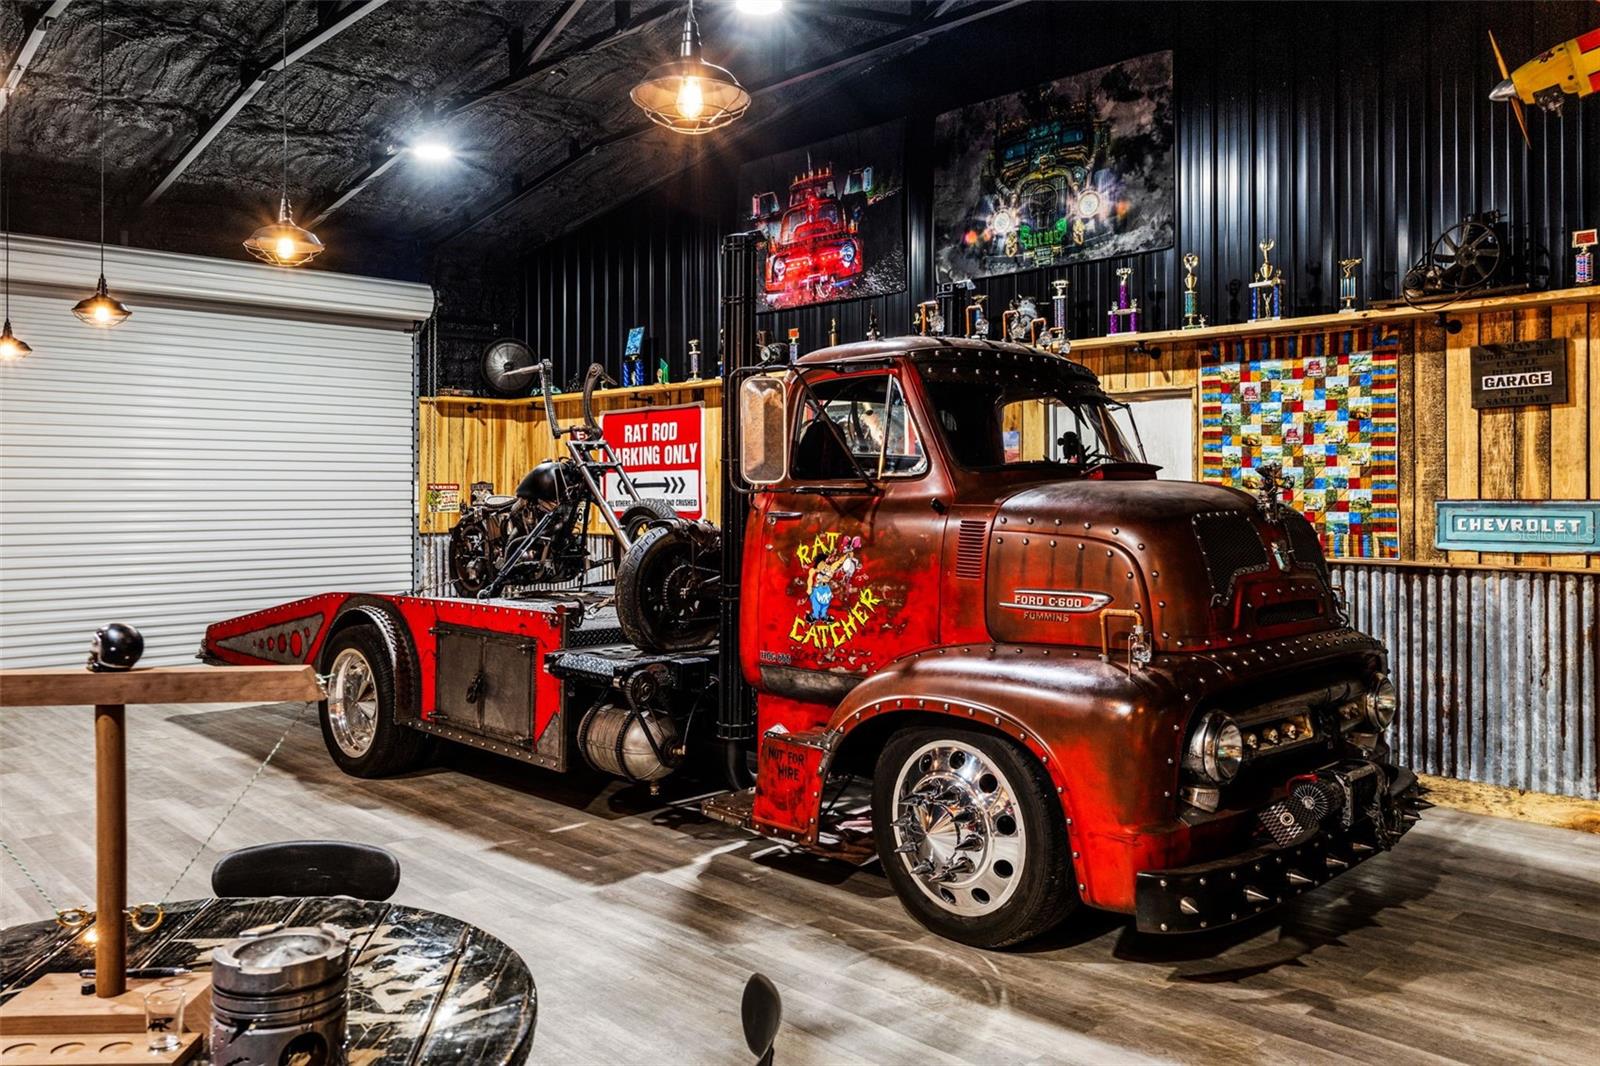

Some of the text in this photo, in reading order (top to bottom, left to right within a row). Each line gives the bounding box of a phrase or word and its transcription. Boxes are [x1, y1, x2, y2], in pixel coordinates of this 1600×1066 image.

[1484, 372, 1551, 388] GARAGE
[624, 422, 678, 443] RAT ROD
[607, 443, 698, 466] ARKING ONLY
[1456, 518, 1581, 532] CHEVROLET
[796, 531, 842, 565] RAT
[1013, 595, 1044, 605] FORD
[789, 588, 881, 649] CATCHER
[1023, 611, 1070, 622] FUMMINS
[787, 752, 805, 766] FOR
